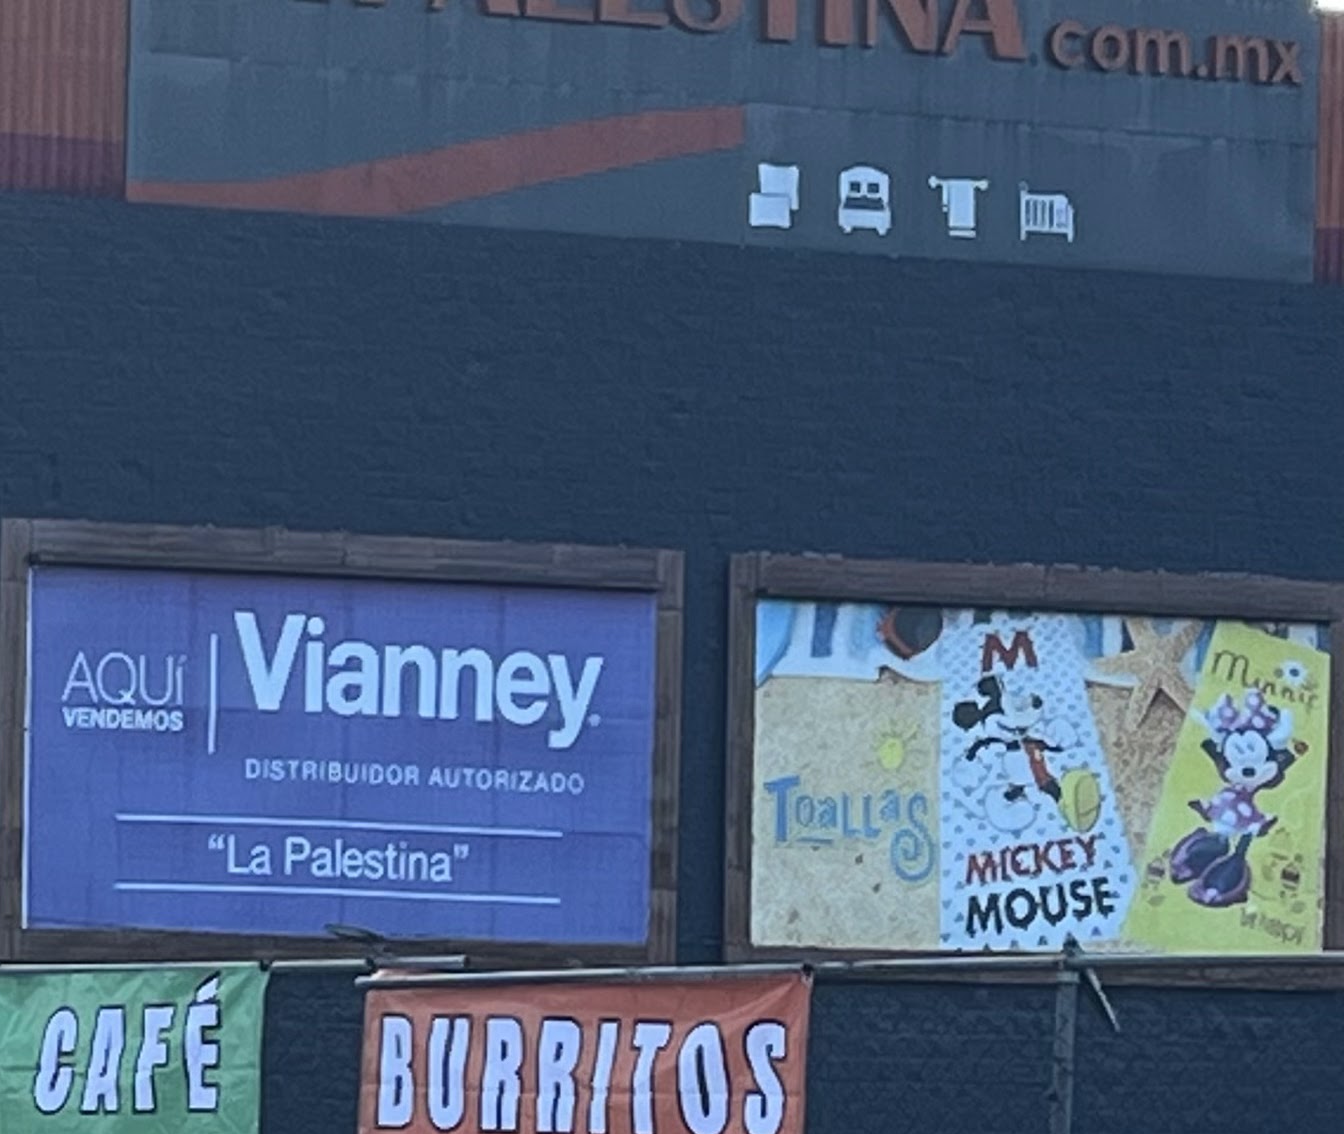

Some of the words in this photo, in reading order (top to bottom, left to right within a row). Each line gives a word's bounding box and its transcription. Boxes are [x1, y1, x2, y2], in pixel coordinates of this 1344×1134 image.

[234, 609, 602, 749] Vianney
[63, 707, 184, 732] VENDEMOS
[245, 757, 420, 787] DISTRIBUIDOR
[428, 766, 584, 795] AUTORIZADO
[965, 835, 1098, 886] MICKEY
[965, 876, 1116, 937] MOUSE
[32, 972, 222, 1114] CAFÉ
